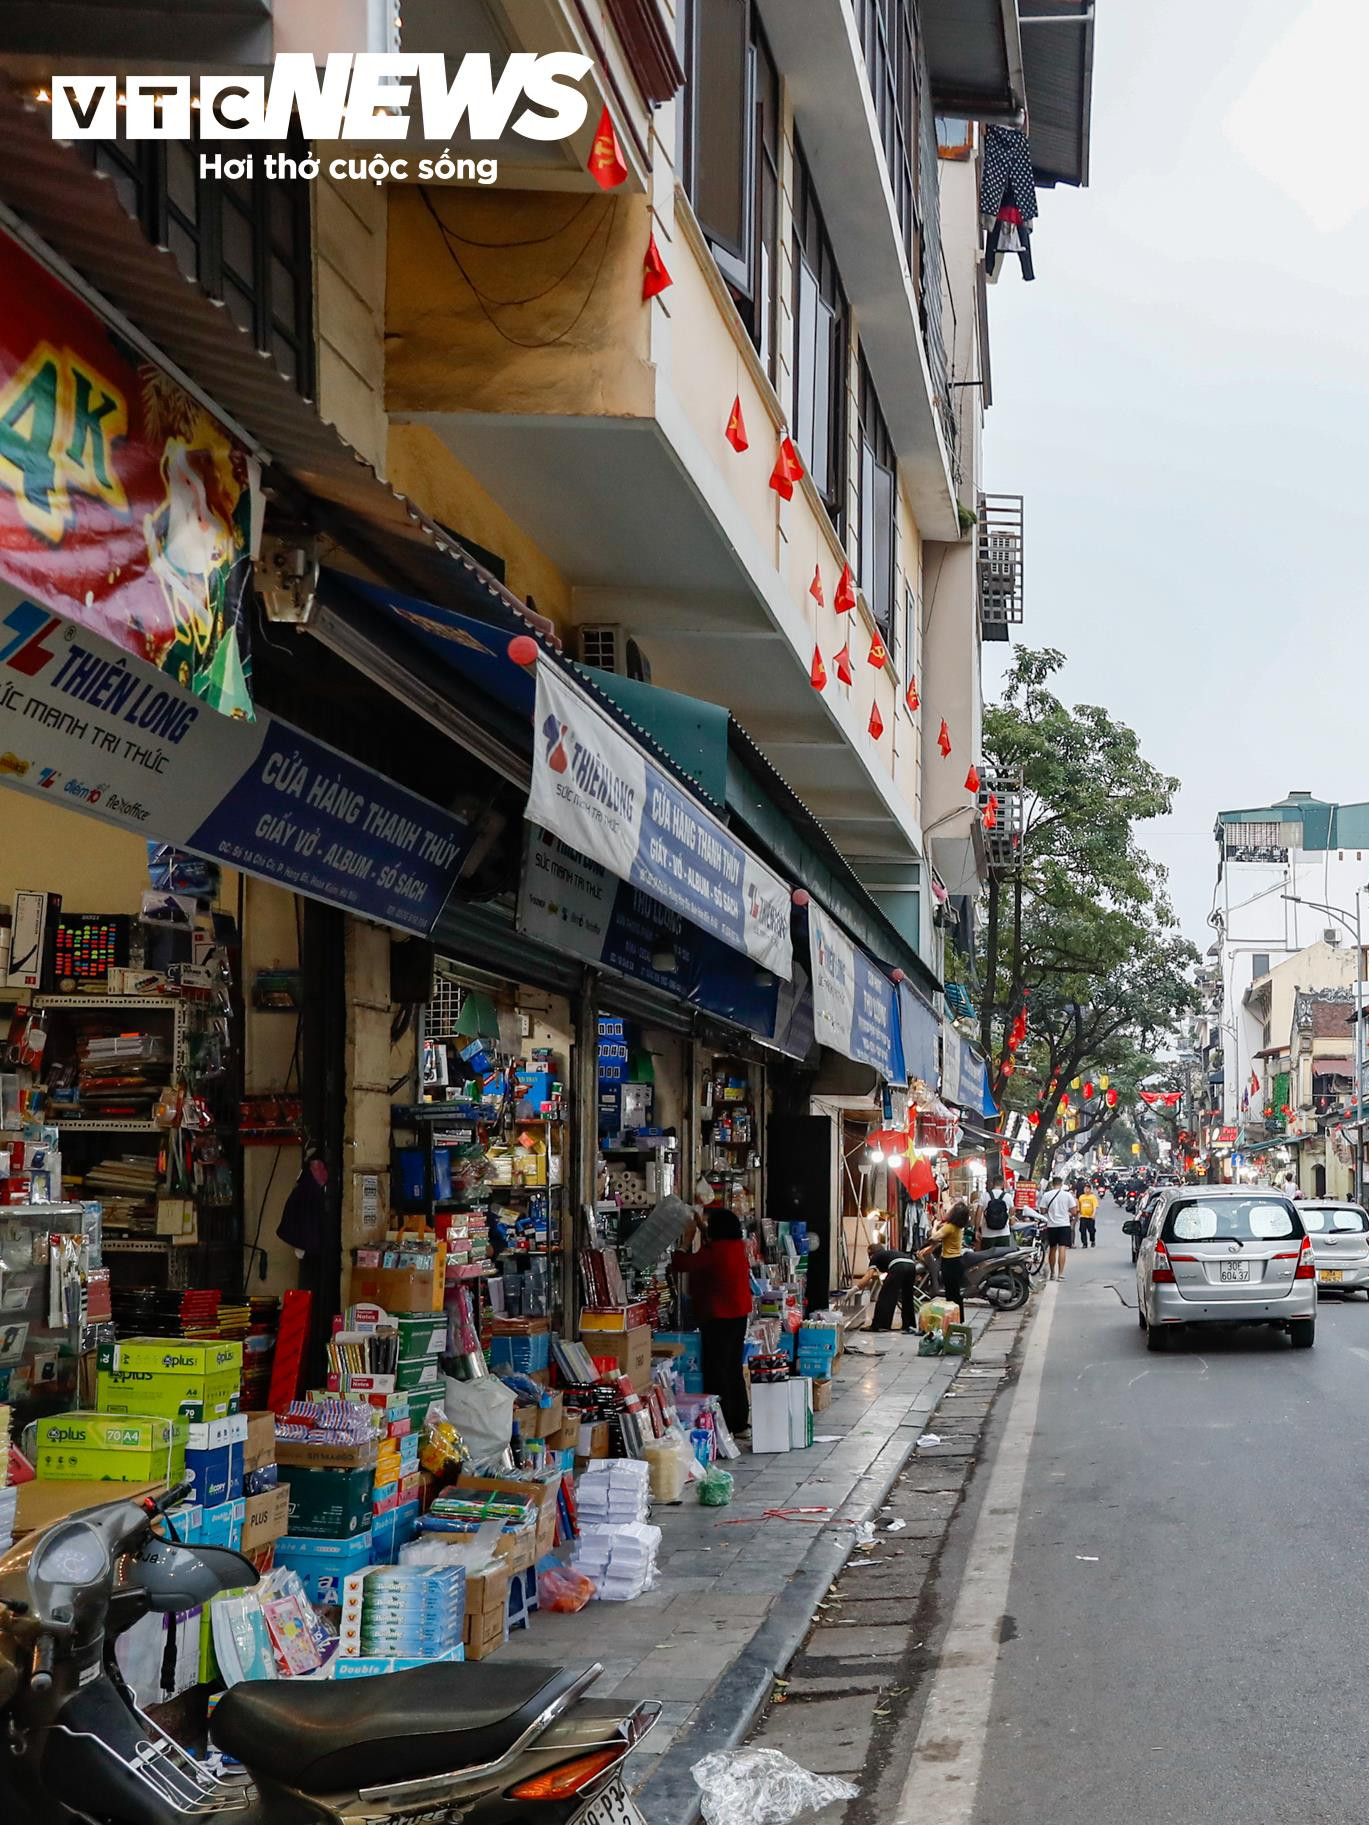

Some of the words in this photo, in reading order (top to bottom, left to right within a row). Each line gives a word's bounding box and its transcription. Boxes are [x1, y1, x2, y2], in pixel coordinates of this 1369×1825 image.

[51, 644, 141, 716] THIÊN
[124, 684, 200, 744] LONG
[23, 697, 90, 740] MẠNH
[91, 726, 121, 754] TRI
[125, 740, 170, 774] THỨC
[261, 750, 310, 798] CỬA
[305, 774, 366, 824] HÀNG
[362, 801, 423, 852] THANH
[651, 783, 671, 831] CỬA
[671, 802, 697, 849] HÀNG
[697, 829, 723, 873] THANH
[255, 811, 297, 847] GIẤY
[323, 843, 375, 880] ALBUM
[396, 869, 429, 902] SÁCH
[184, 1409, 196, 1417] 70
[186, 1388, 198, 1397] A4
[106, 1429, 122, 1441] 70
[123, 1429, 140, 1441] A4
[250, 1510, 268, 1528] PLUS
[339, 1664, 381, 1675] Double
